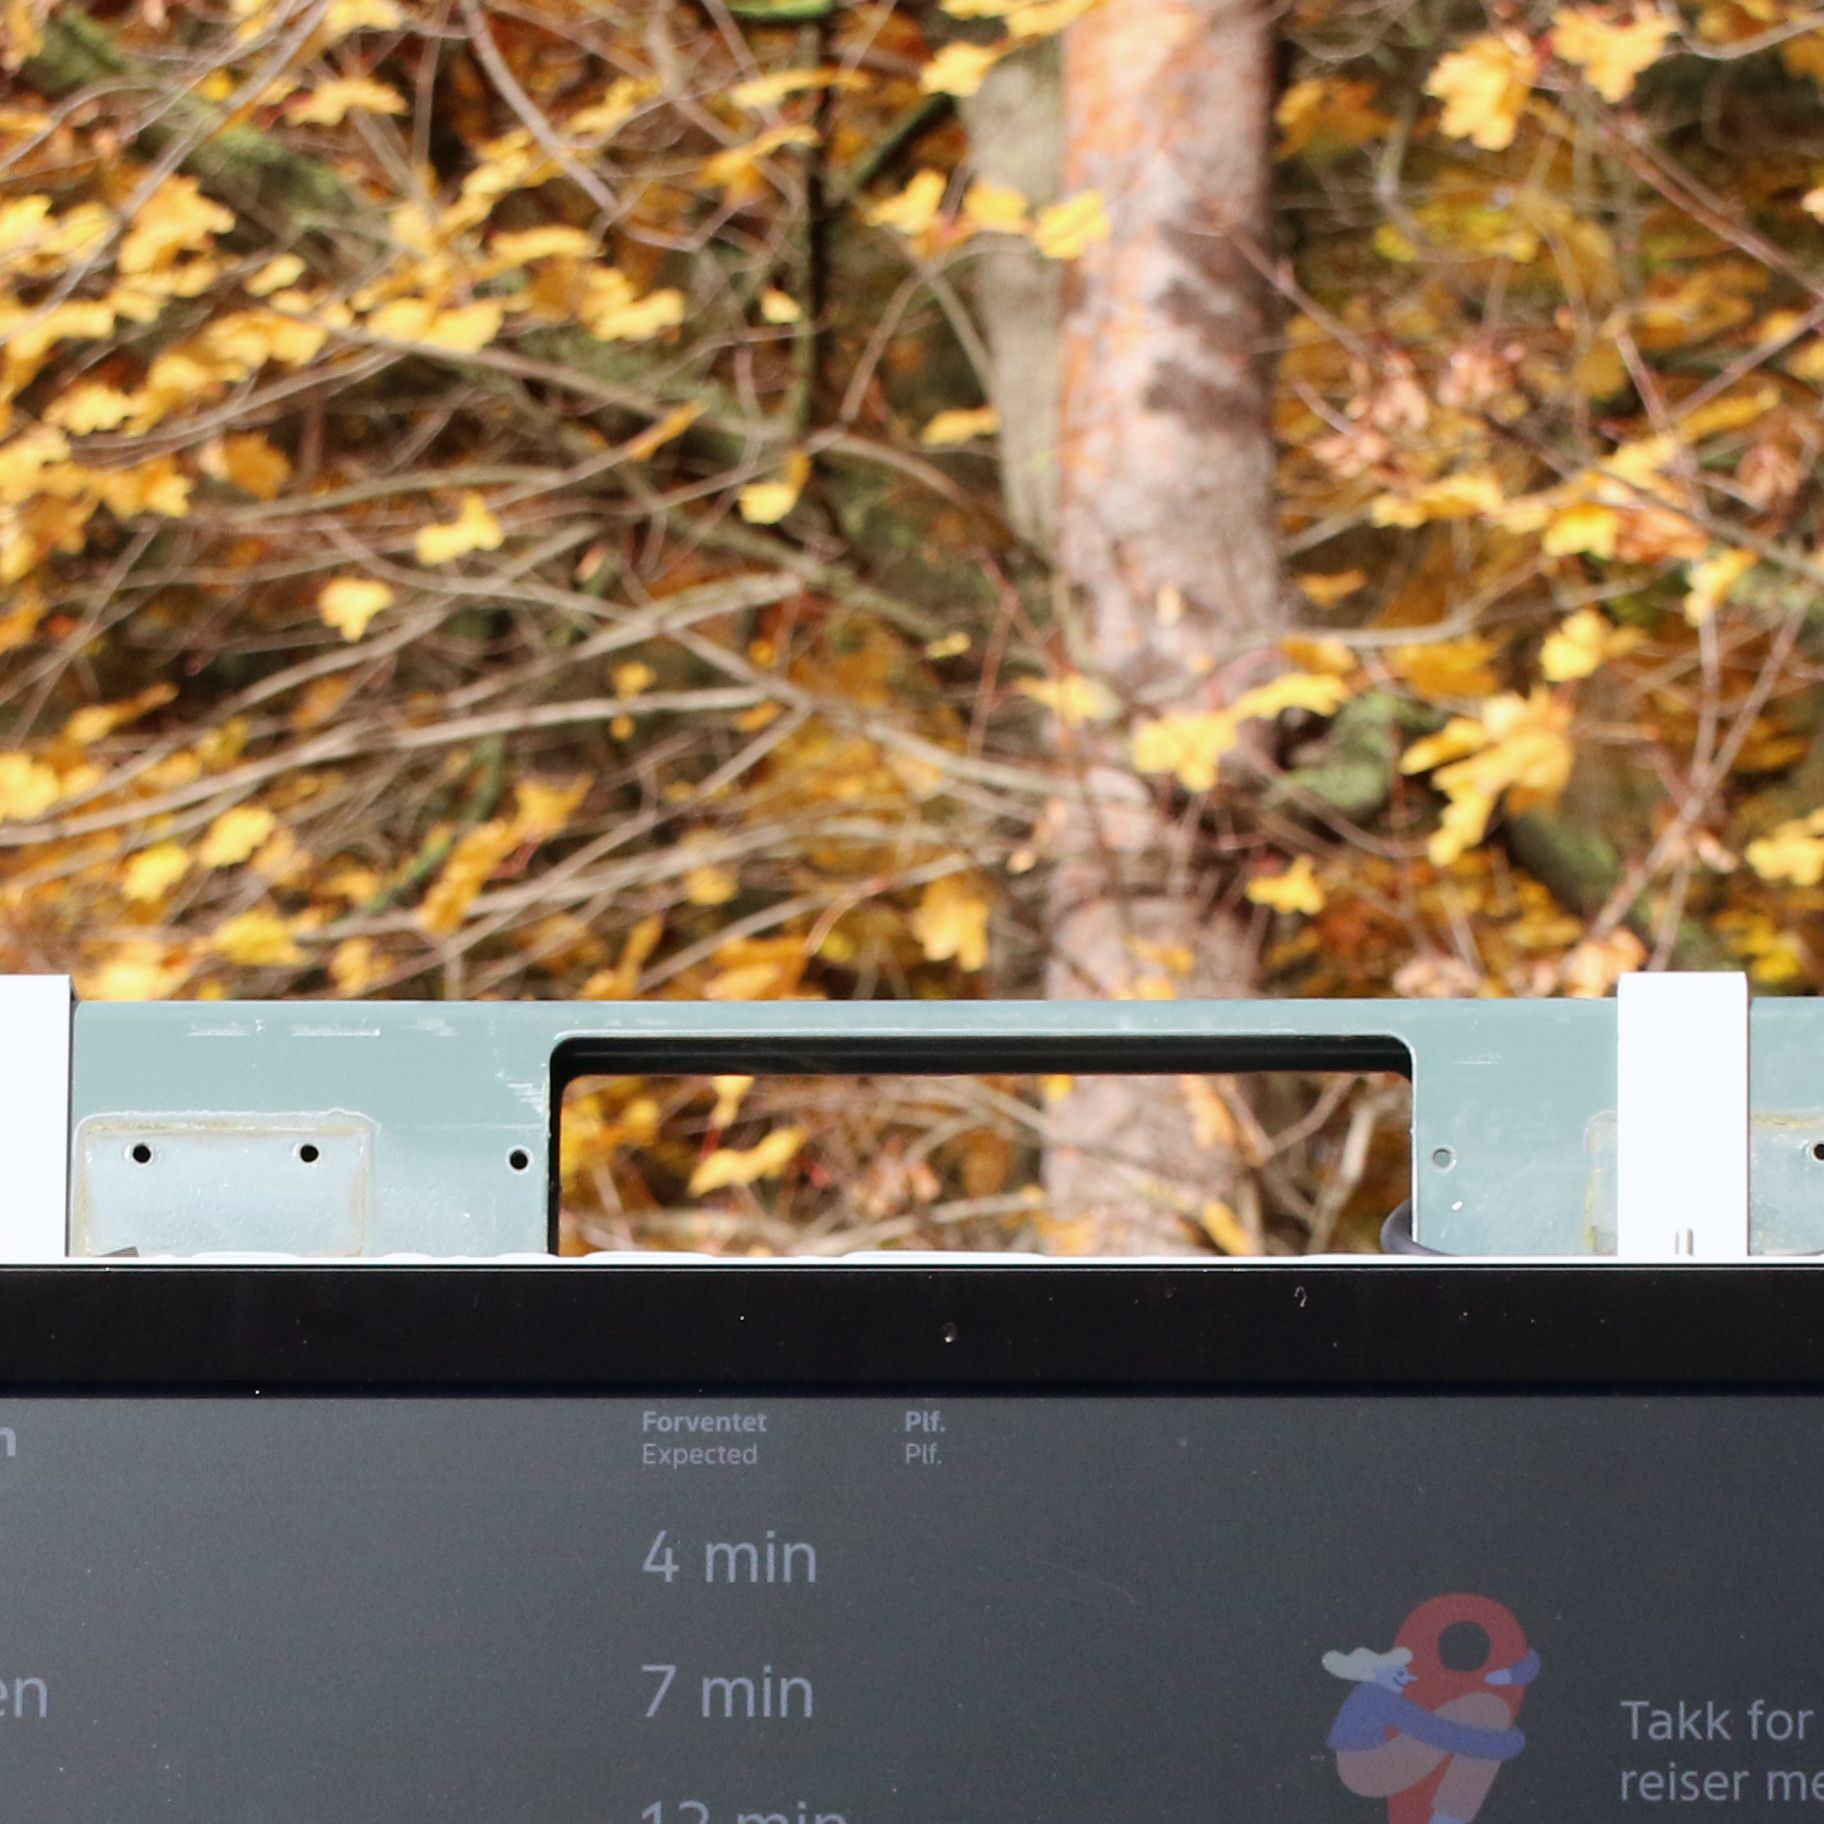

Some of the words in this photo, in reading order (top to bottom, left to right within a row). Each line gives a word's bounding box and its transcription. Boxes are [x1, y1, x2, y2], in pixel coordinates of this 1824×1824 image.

[642, 1410, 767, 1434] Forventet
[904, 1410, 946, 1434] Plf.
[642, 1442, 758, 1470] Expected
[904, 1442, 942, 1465] Plf.
[642, 1530, 679, 1583] 4
[704, 1530, 818, 1583] min
[640, 1665, 677, 1718] 7
[701, 1665, 814, 1718] min
[1621, 1699, 1730, 1741] Takk
[1747, 1699, 1813, 1741] for
[1620, 1760, 1749, 1802] reiser
